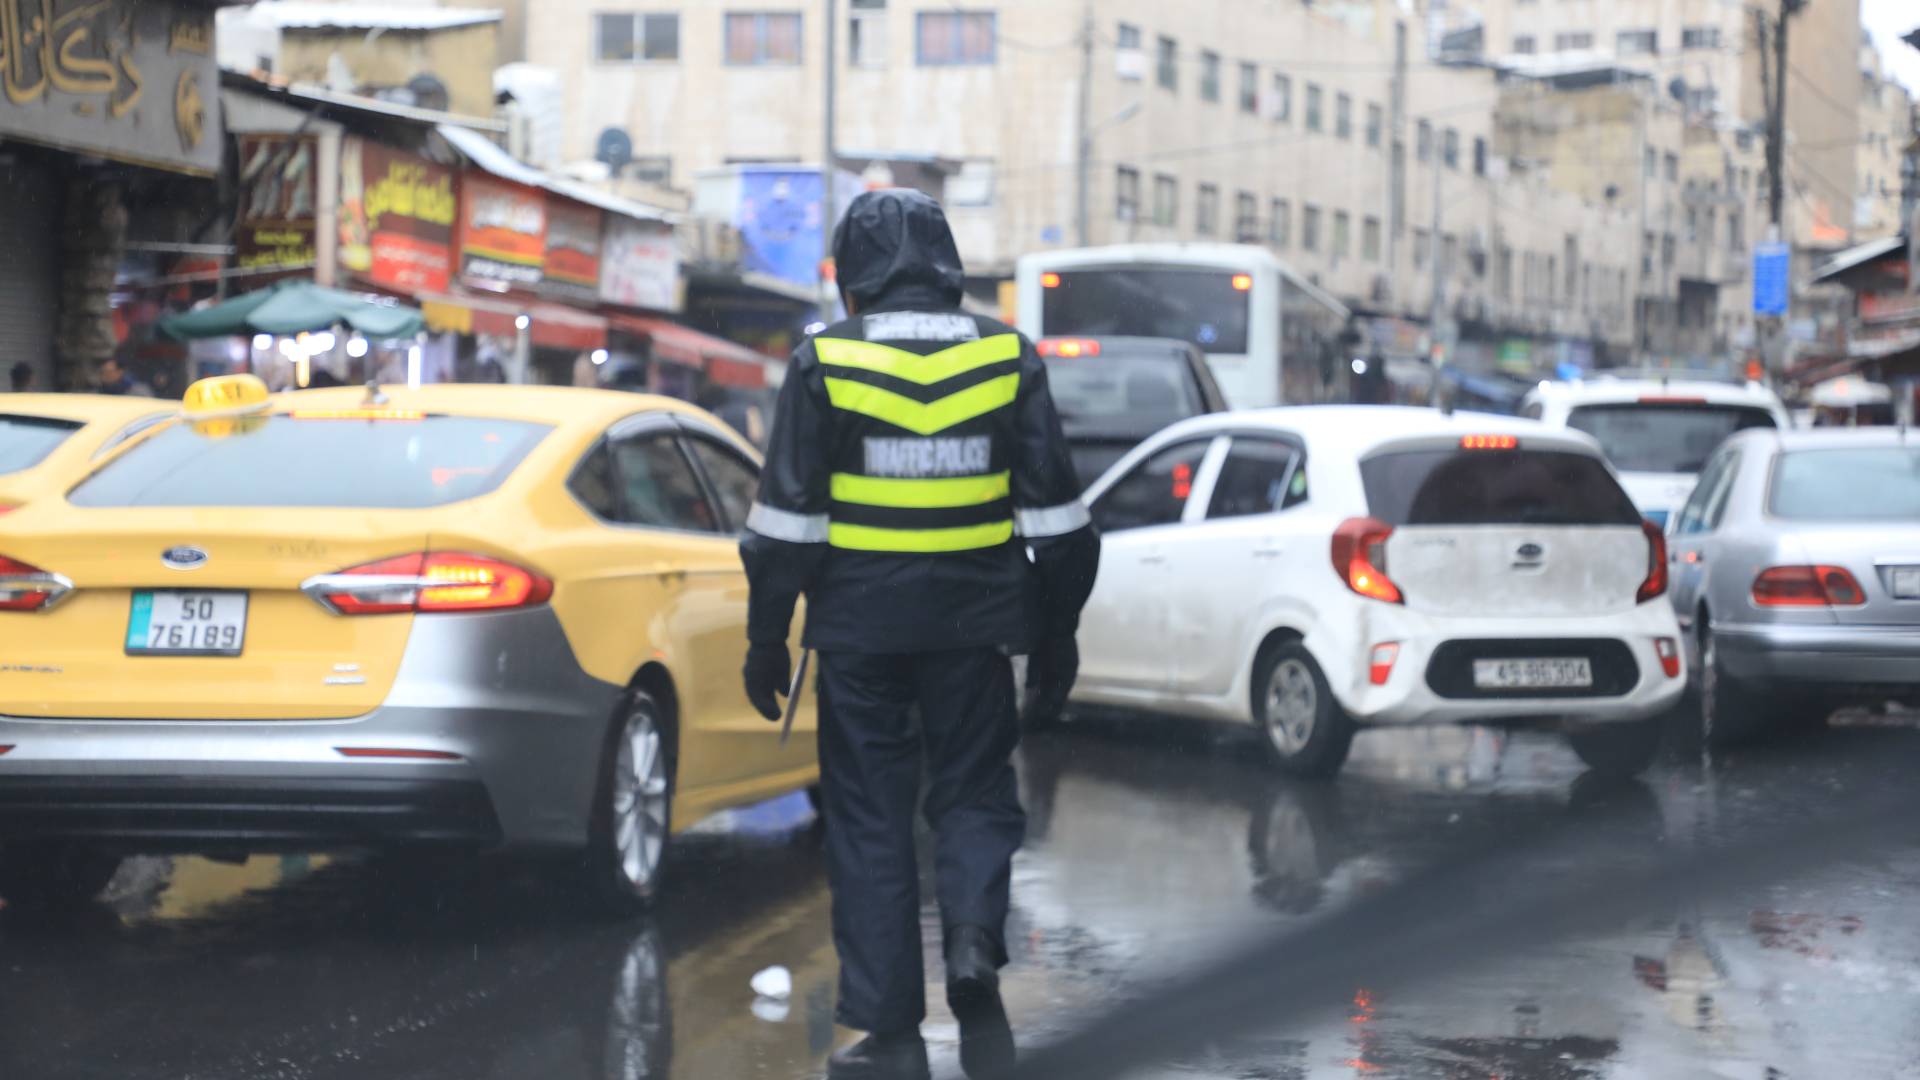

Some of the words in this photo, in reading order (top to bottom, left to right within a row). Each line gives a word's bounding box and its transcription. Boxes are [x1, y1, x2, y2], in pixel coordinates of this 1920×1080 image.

[864, 436, 934, 476] TRAFFIC
[936, 435, 990, 473] POLICE
[180, 597, 214, 621] 50
[151, 625, 238, 649] 76189
